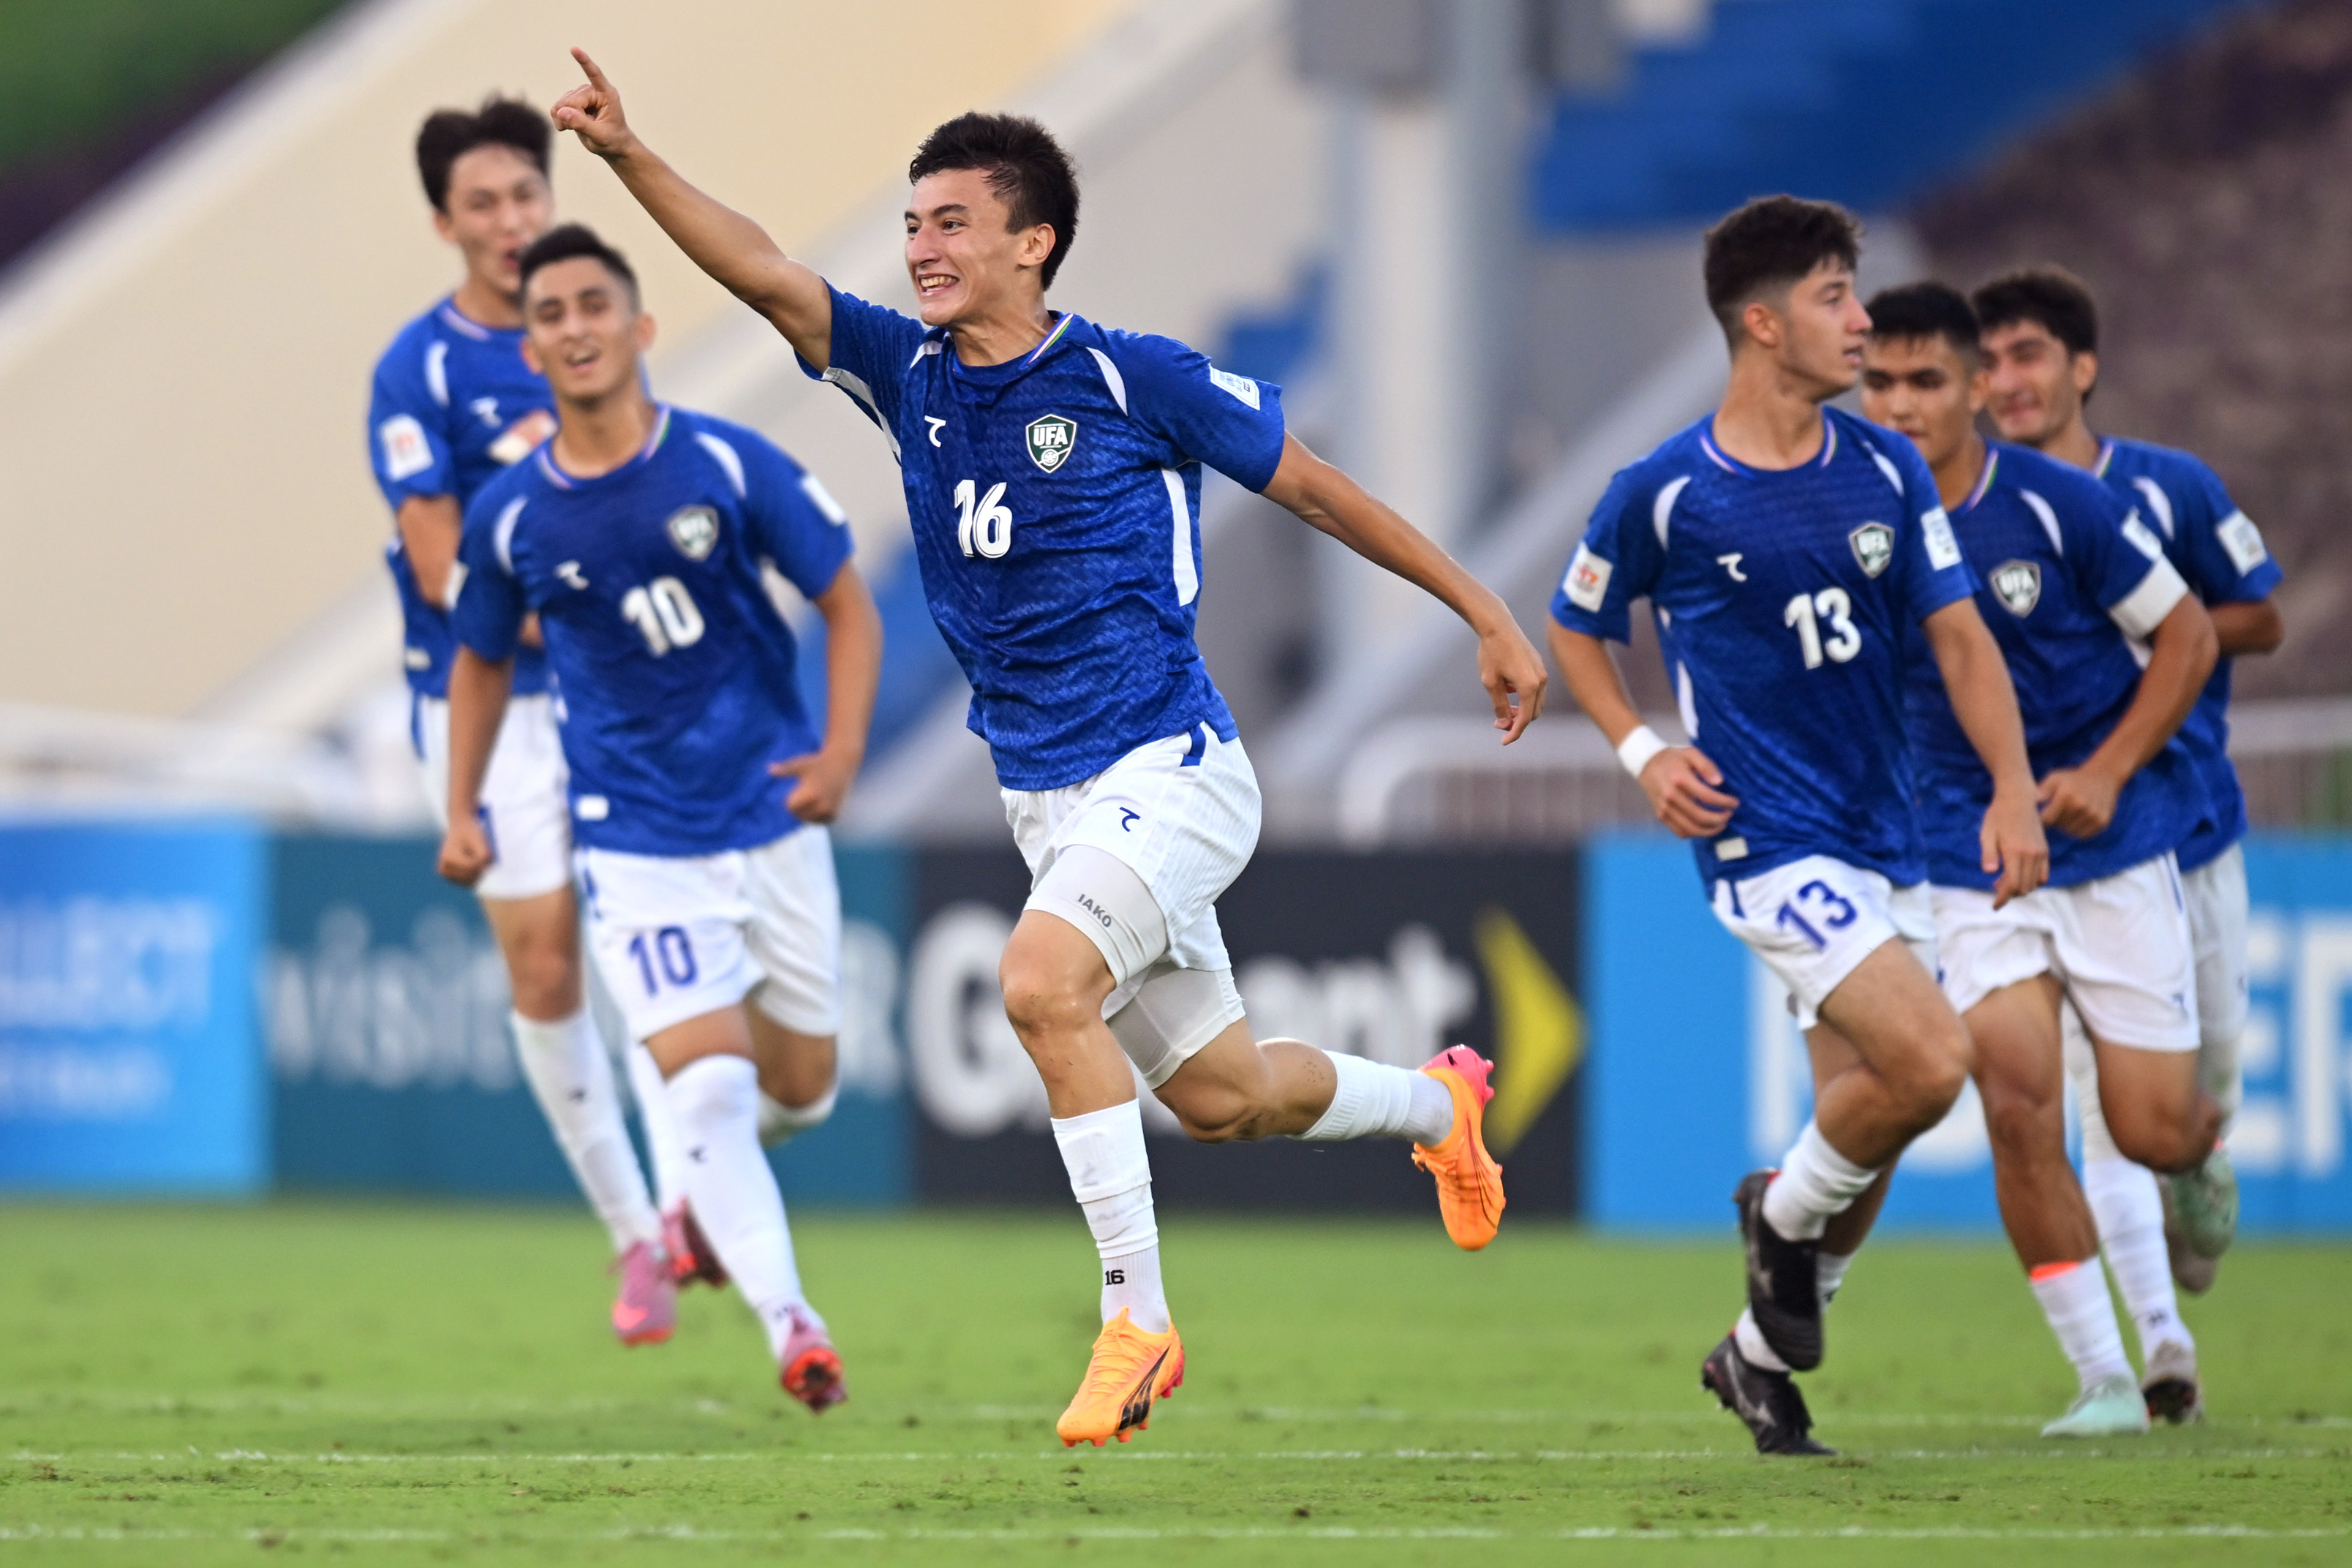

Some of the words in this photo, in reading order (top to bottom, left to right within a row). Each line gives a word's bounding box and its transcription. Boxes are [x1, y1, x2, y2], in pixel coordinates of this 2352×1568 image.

[1033, 426, 1068, 446] UFA
[954, 479, 1013, 559] 16
[622, 576, 704, 656] 10
[1784, 587, 1862, 670] 13
[1776, 880, 1858, 949] 13
[629, 926, 698, 996] 10
[1105, 1269, 1125, 1286] 16
